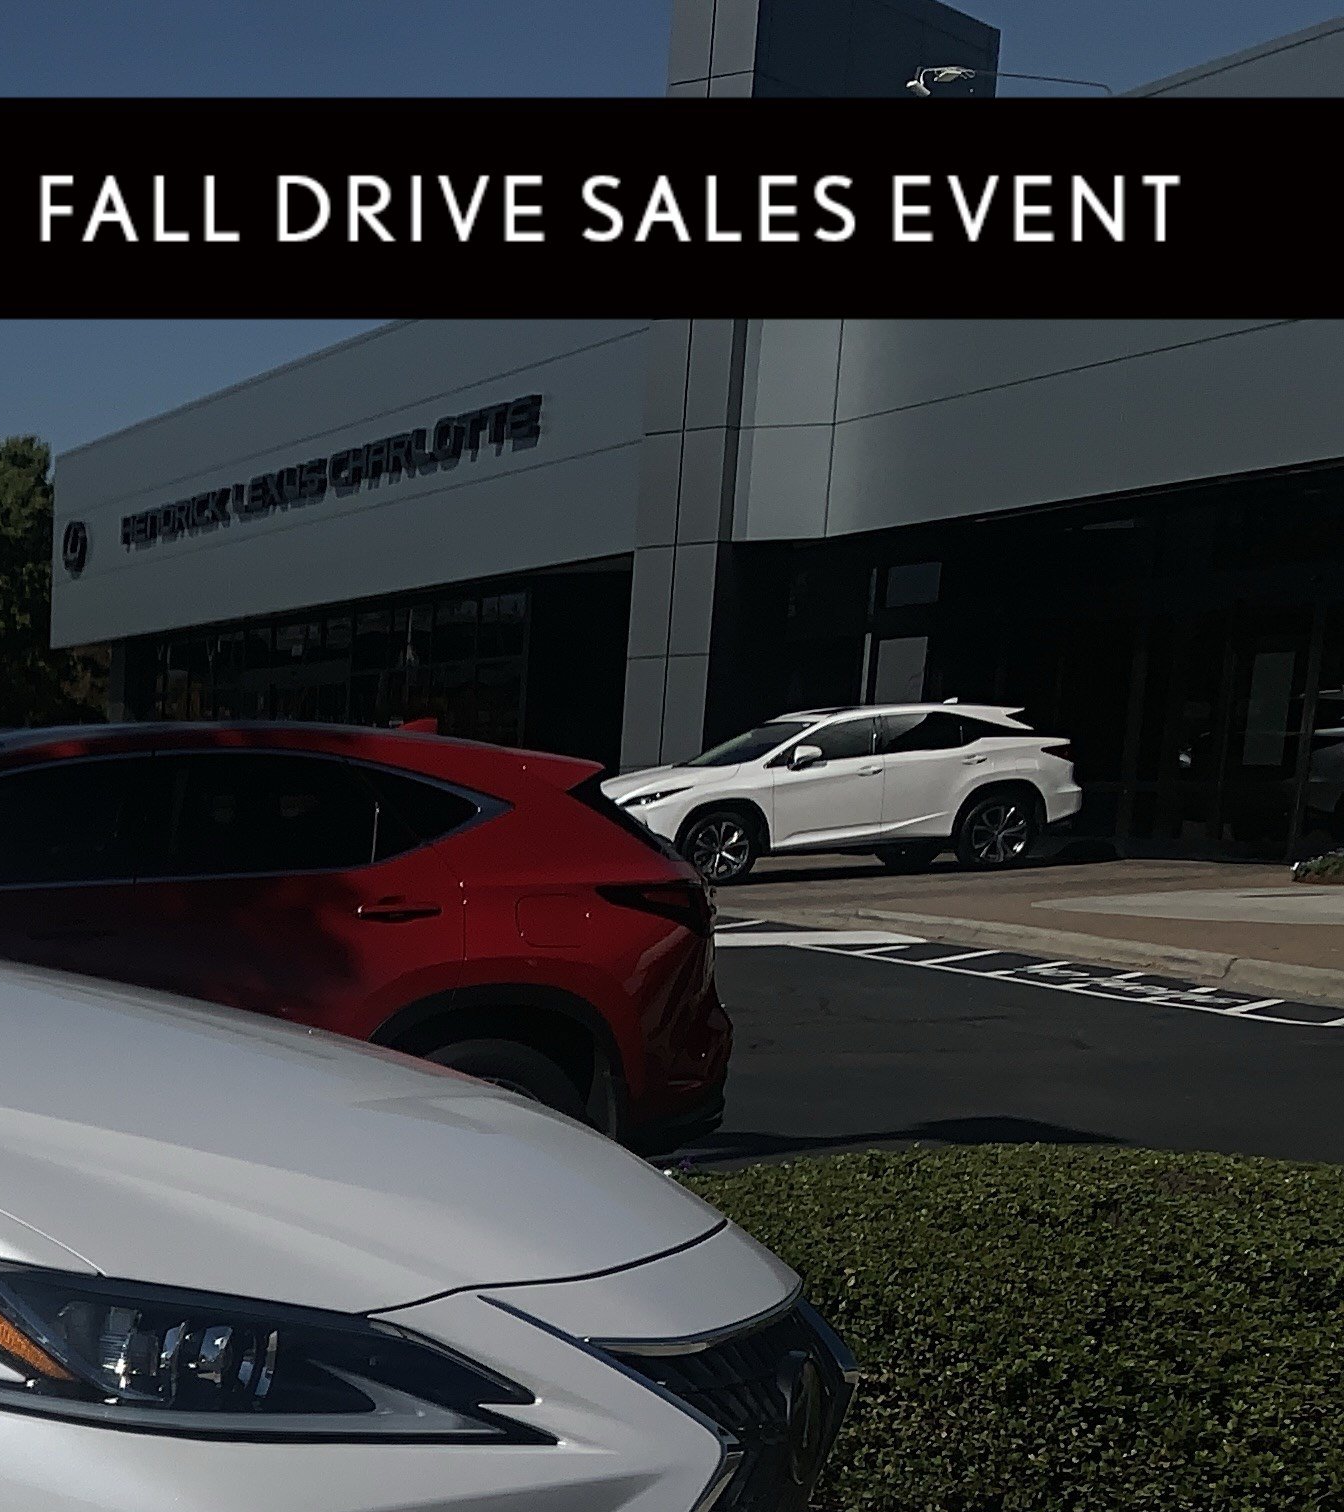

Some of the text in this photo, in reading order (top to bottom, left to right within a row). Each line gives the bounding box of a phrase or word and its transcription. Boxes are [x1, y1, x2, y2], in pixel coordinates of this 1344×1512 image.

[120, 395, 543, 549] HENDRICK LEXUS CHARLOTTE
